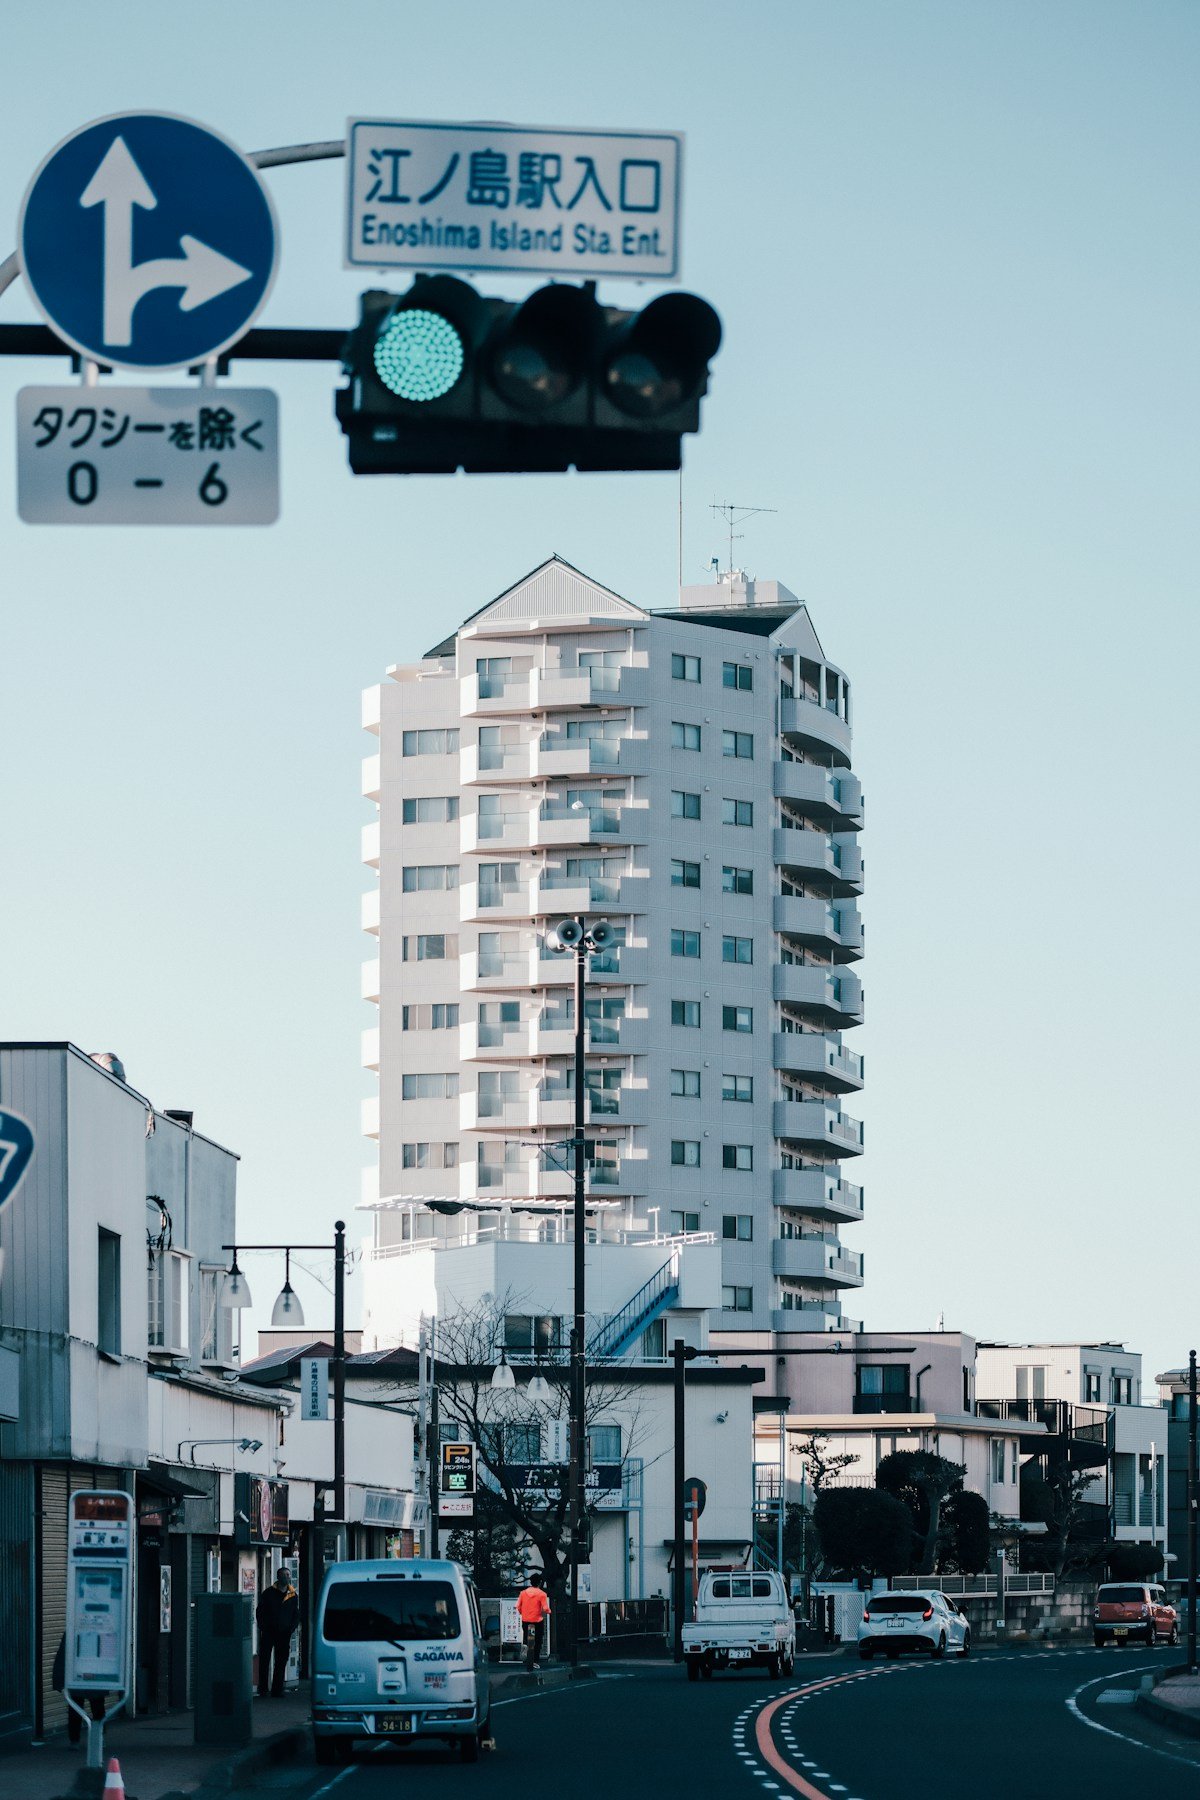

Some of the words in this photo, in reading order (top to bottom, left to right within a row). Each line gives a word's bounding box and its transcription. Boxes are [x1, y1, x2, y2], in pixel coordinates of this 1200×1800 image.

[366, 148, 660, 213] 江ノ島駅入口
[362, 214, 480, 250] Enoshima
[490, 220, 562, 252] Island
[573, 223, 615, 255] Sta.
[622, 225, 666, 256] Ent.
[33, 407, 264, 450] タクシーを除く
[445, 1445, 470, 1464] P
[449, 1473, 467, 1490] 空
[413, 1652, 464, 1661] SAGAWA
[382, 1720, 411, 1731] 94-18
